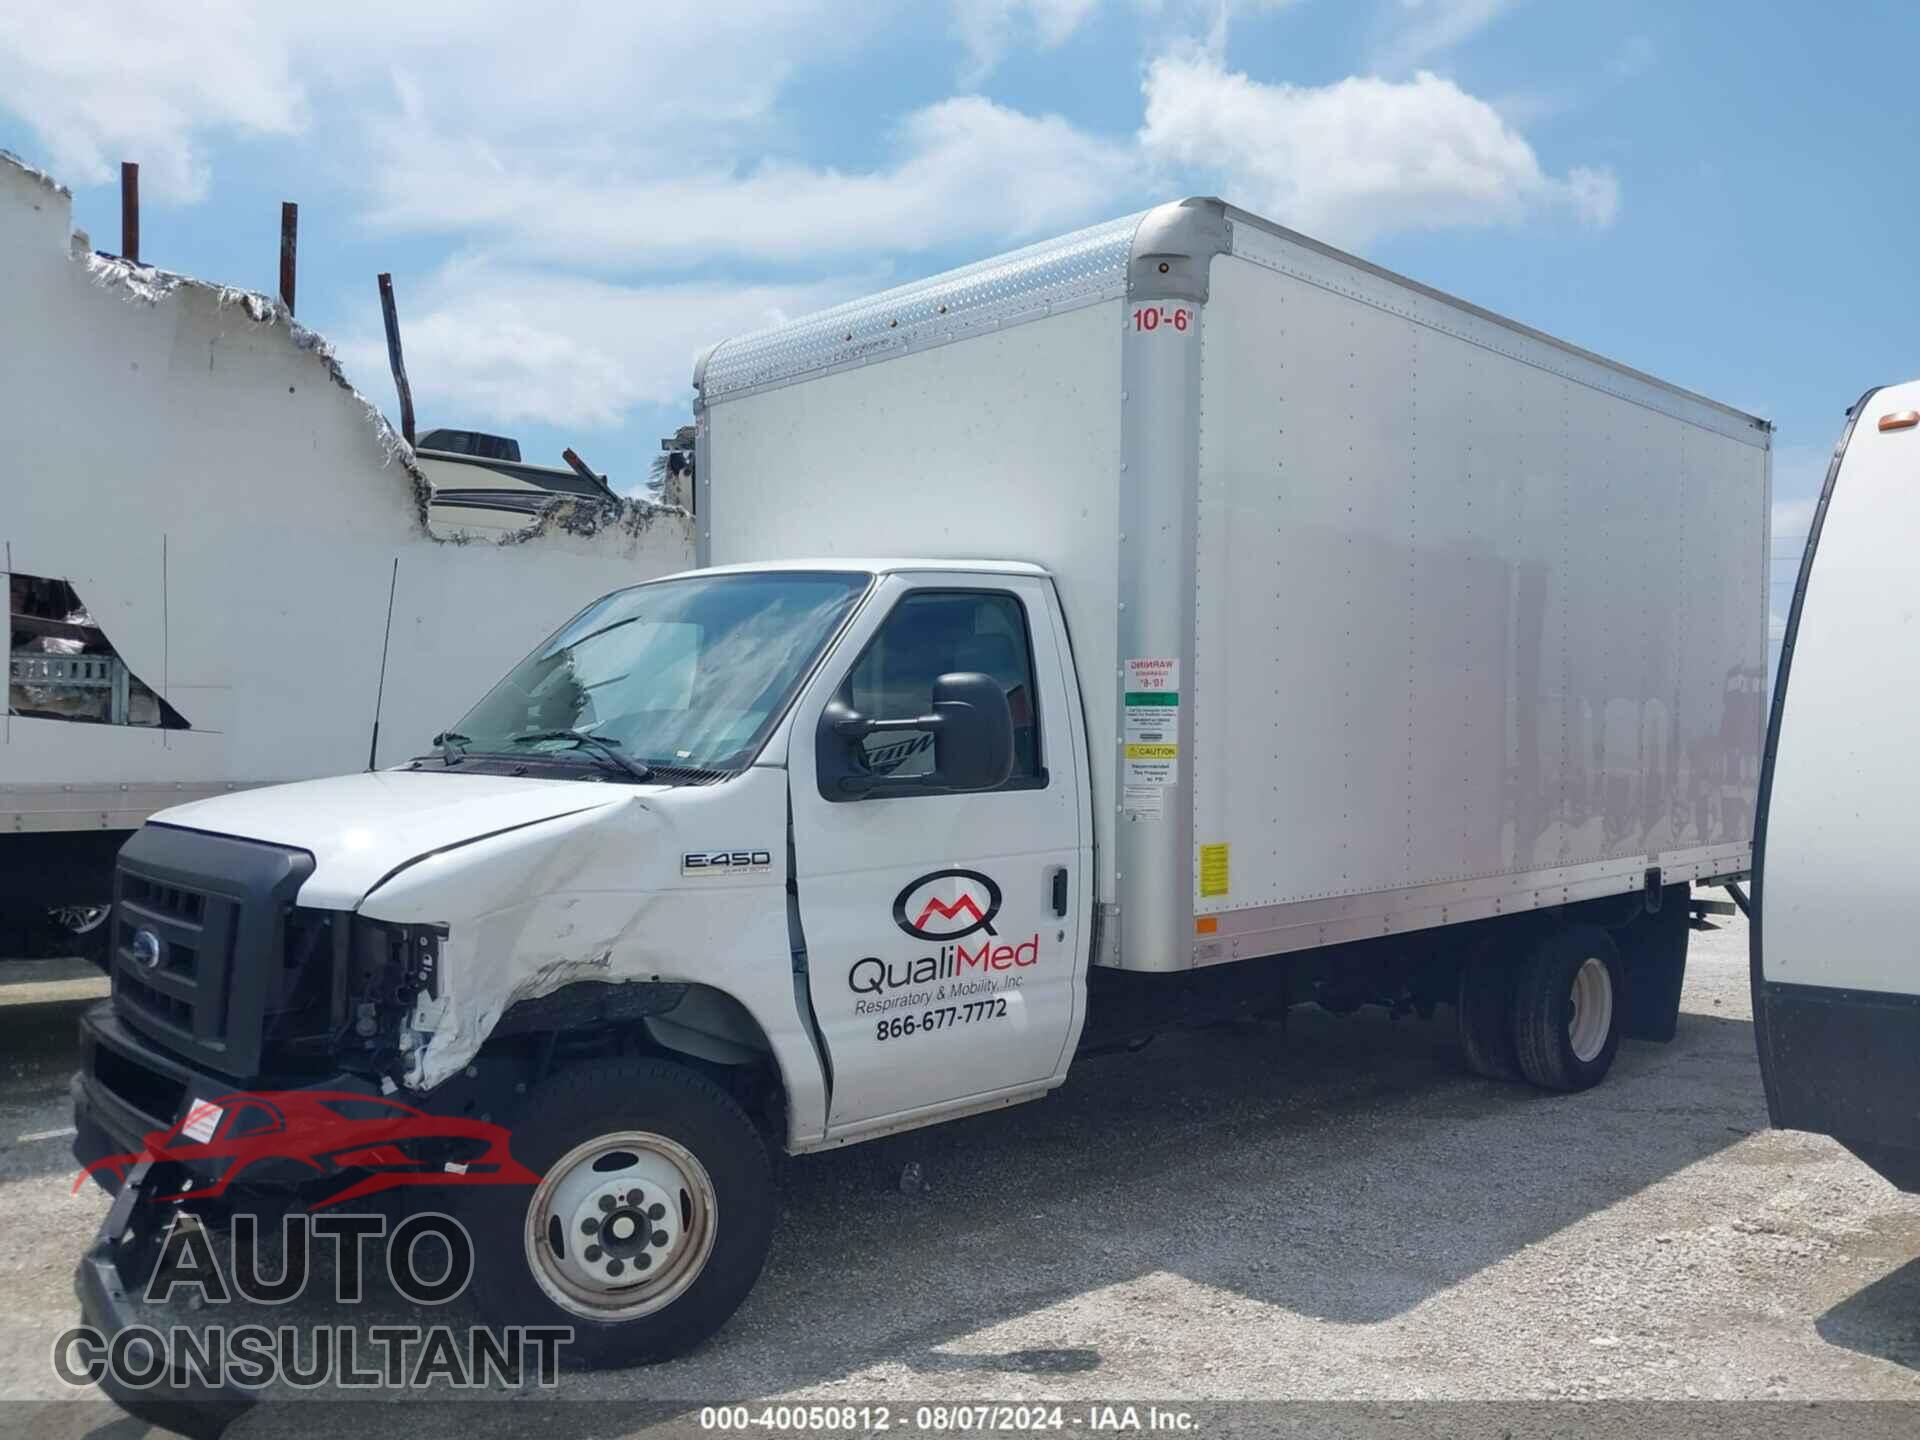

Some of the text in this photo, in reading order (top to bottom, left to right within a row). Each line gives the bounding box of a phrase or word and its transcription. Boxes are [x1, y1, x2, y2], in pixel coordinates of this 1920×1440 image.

[1138, 747, 1176, 756] CAUTION
[848, 933, 1039, 995] QualiMed
[855, 991, 934, 1016] Respiratory
[936, 987, 945, 1001] &
[950, 977, 999, 998] Mobility,
[876, 998, 1008, 1041] 866-677-7772
